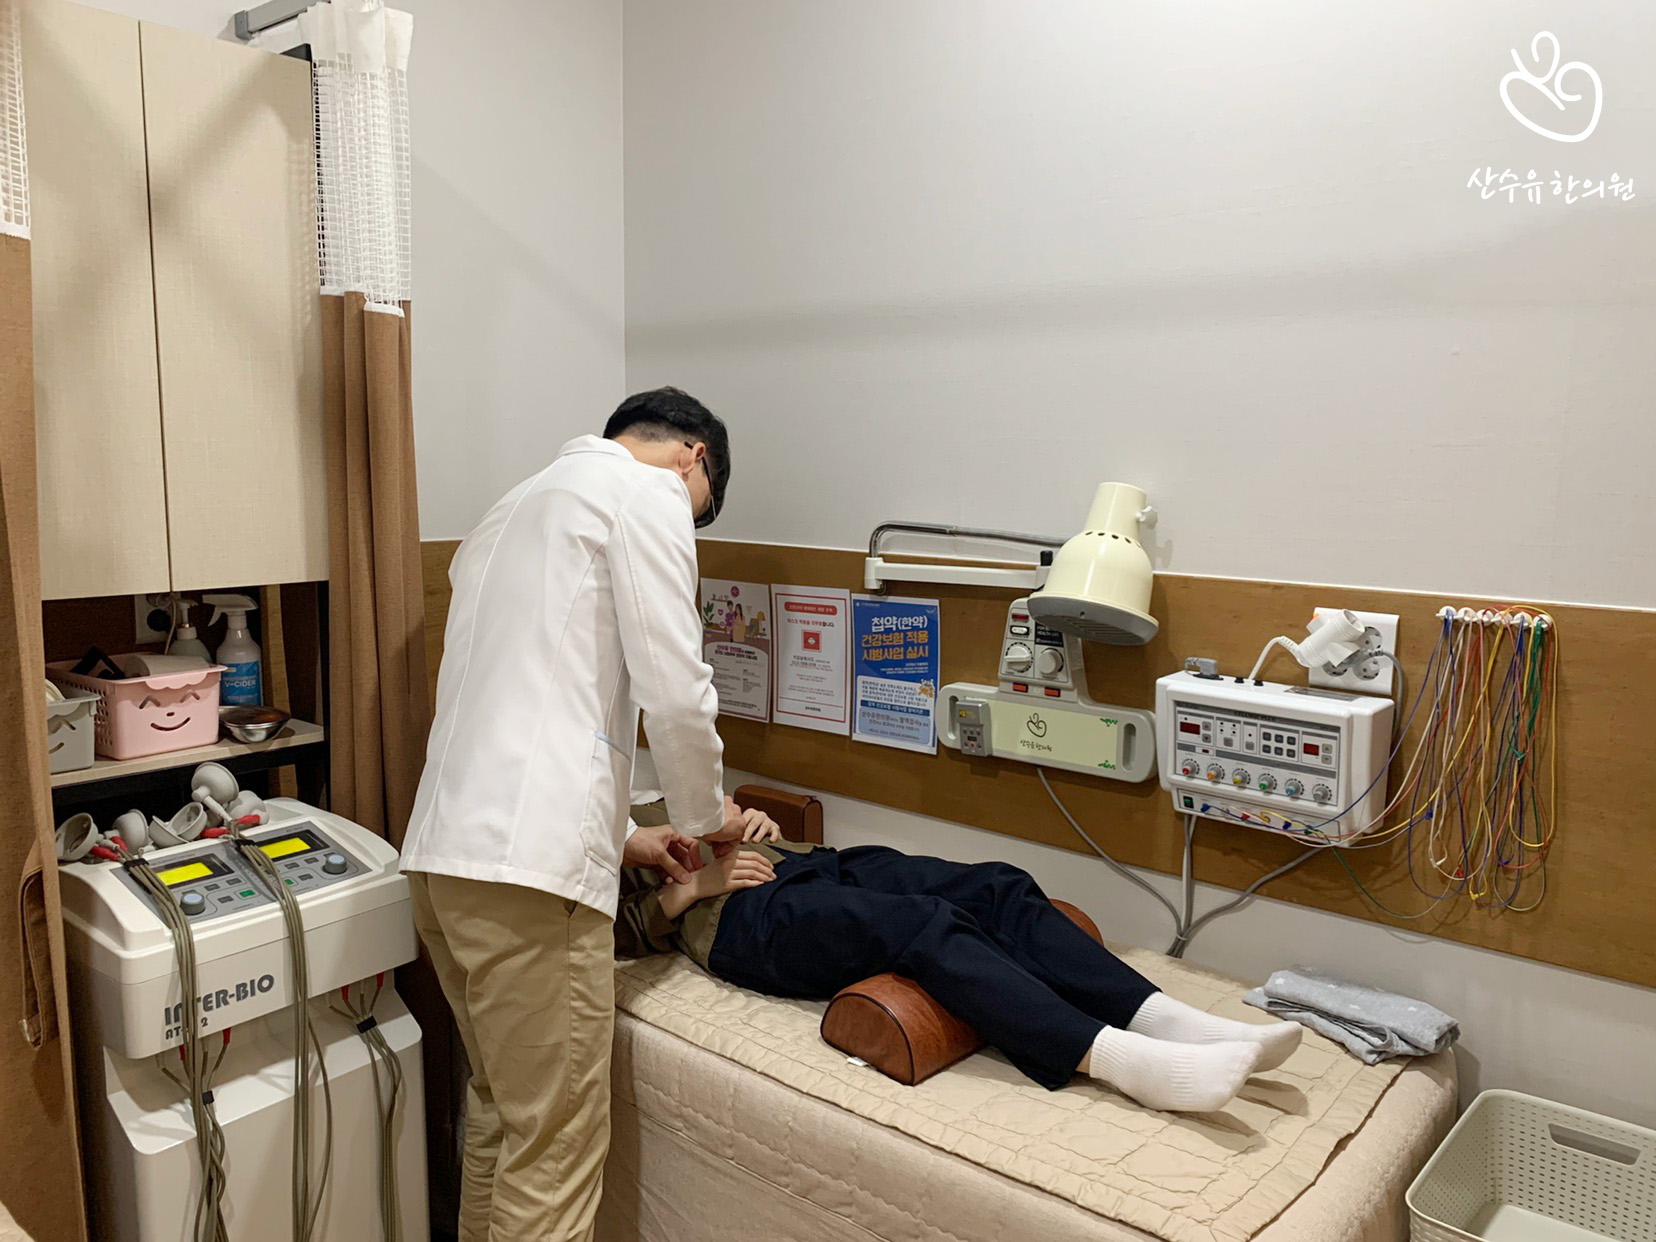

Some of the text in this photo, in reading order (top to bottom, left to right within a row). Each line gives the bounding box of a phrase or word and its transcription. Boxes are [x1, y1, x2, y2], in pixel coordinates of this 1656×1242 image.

[872, 616, 928, 632] 첩약(한약)
[862, 630, 928, 648] 건강보험 적용
[862, 646, 928, 661] 시범사업 실시
